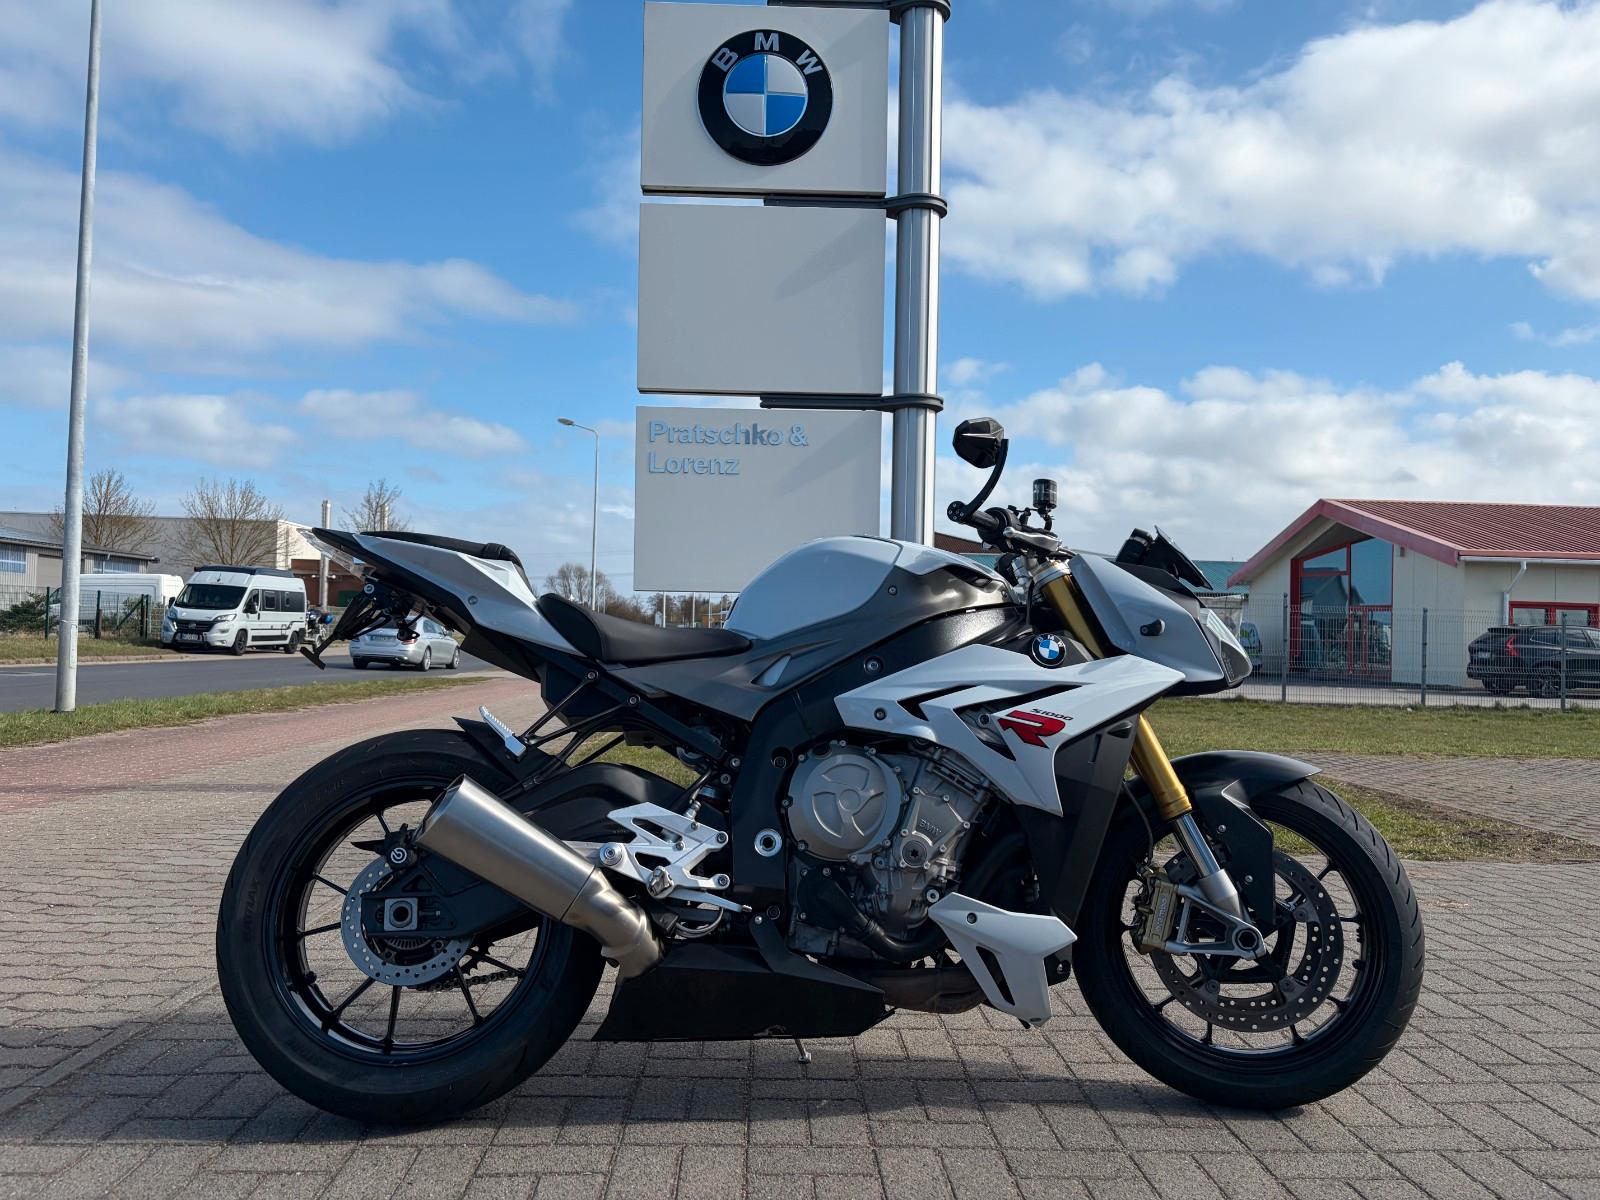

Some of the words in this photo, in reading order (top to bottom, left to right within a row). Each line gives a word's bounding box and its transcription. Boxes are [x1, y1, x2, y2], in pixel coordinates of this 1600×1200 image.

[711, 32, 823, 76] BMW
[648, 421, 784, 446] Pratschko
[788, 423, 809, 446] &
[648, 452, 740, 475] Lorenz
[1036, 634, 1065, 648] BMW
[919, 818, 942, 835] BMW
